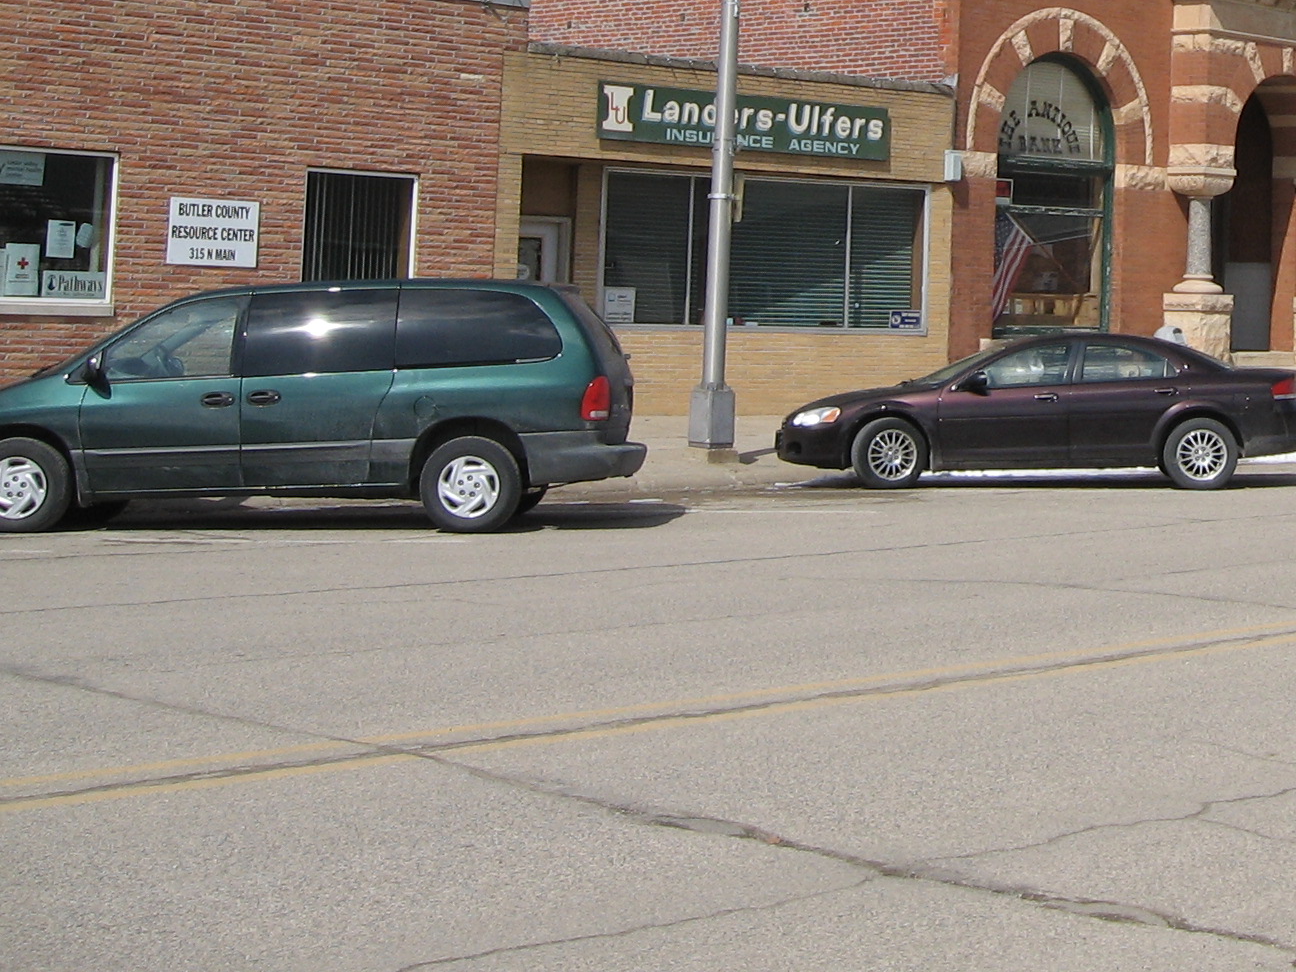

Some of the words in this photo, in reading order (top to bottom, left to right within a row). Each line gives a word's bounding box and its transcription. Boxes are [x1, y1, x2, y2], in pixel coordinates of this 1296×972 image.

[641, 89, 884, 141] Landrs-Ulfers
[666, 128, 774, 149] INSUNCE
[788, 138, 860, 155] AGENCY
[1018, 135, 1063, 154] BANK
[178, 202, 213, 218] BUTLER
[215, 205, 251, 220] COUNTY
[171, 225, 219, 241] RESOURCE
[220, 228, 255, 242] CENTER
[188, 247, 205, 260] 315
[206, 248, 213, 260] N
[214, 249, 236, 261] MAIN
[58, 274, 103, 292] Pathways
